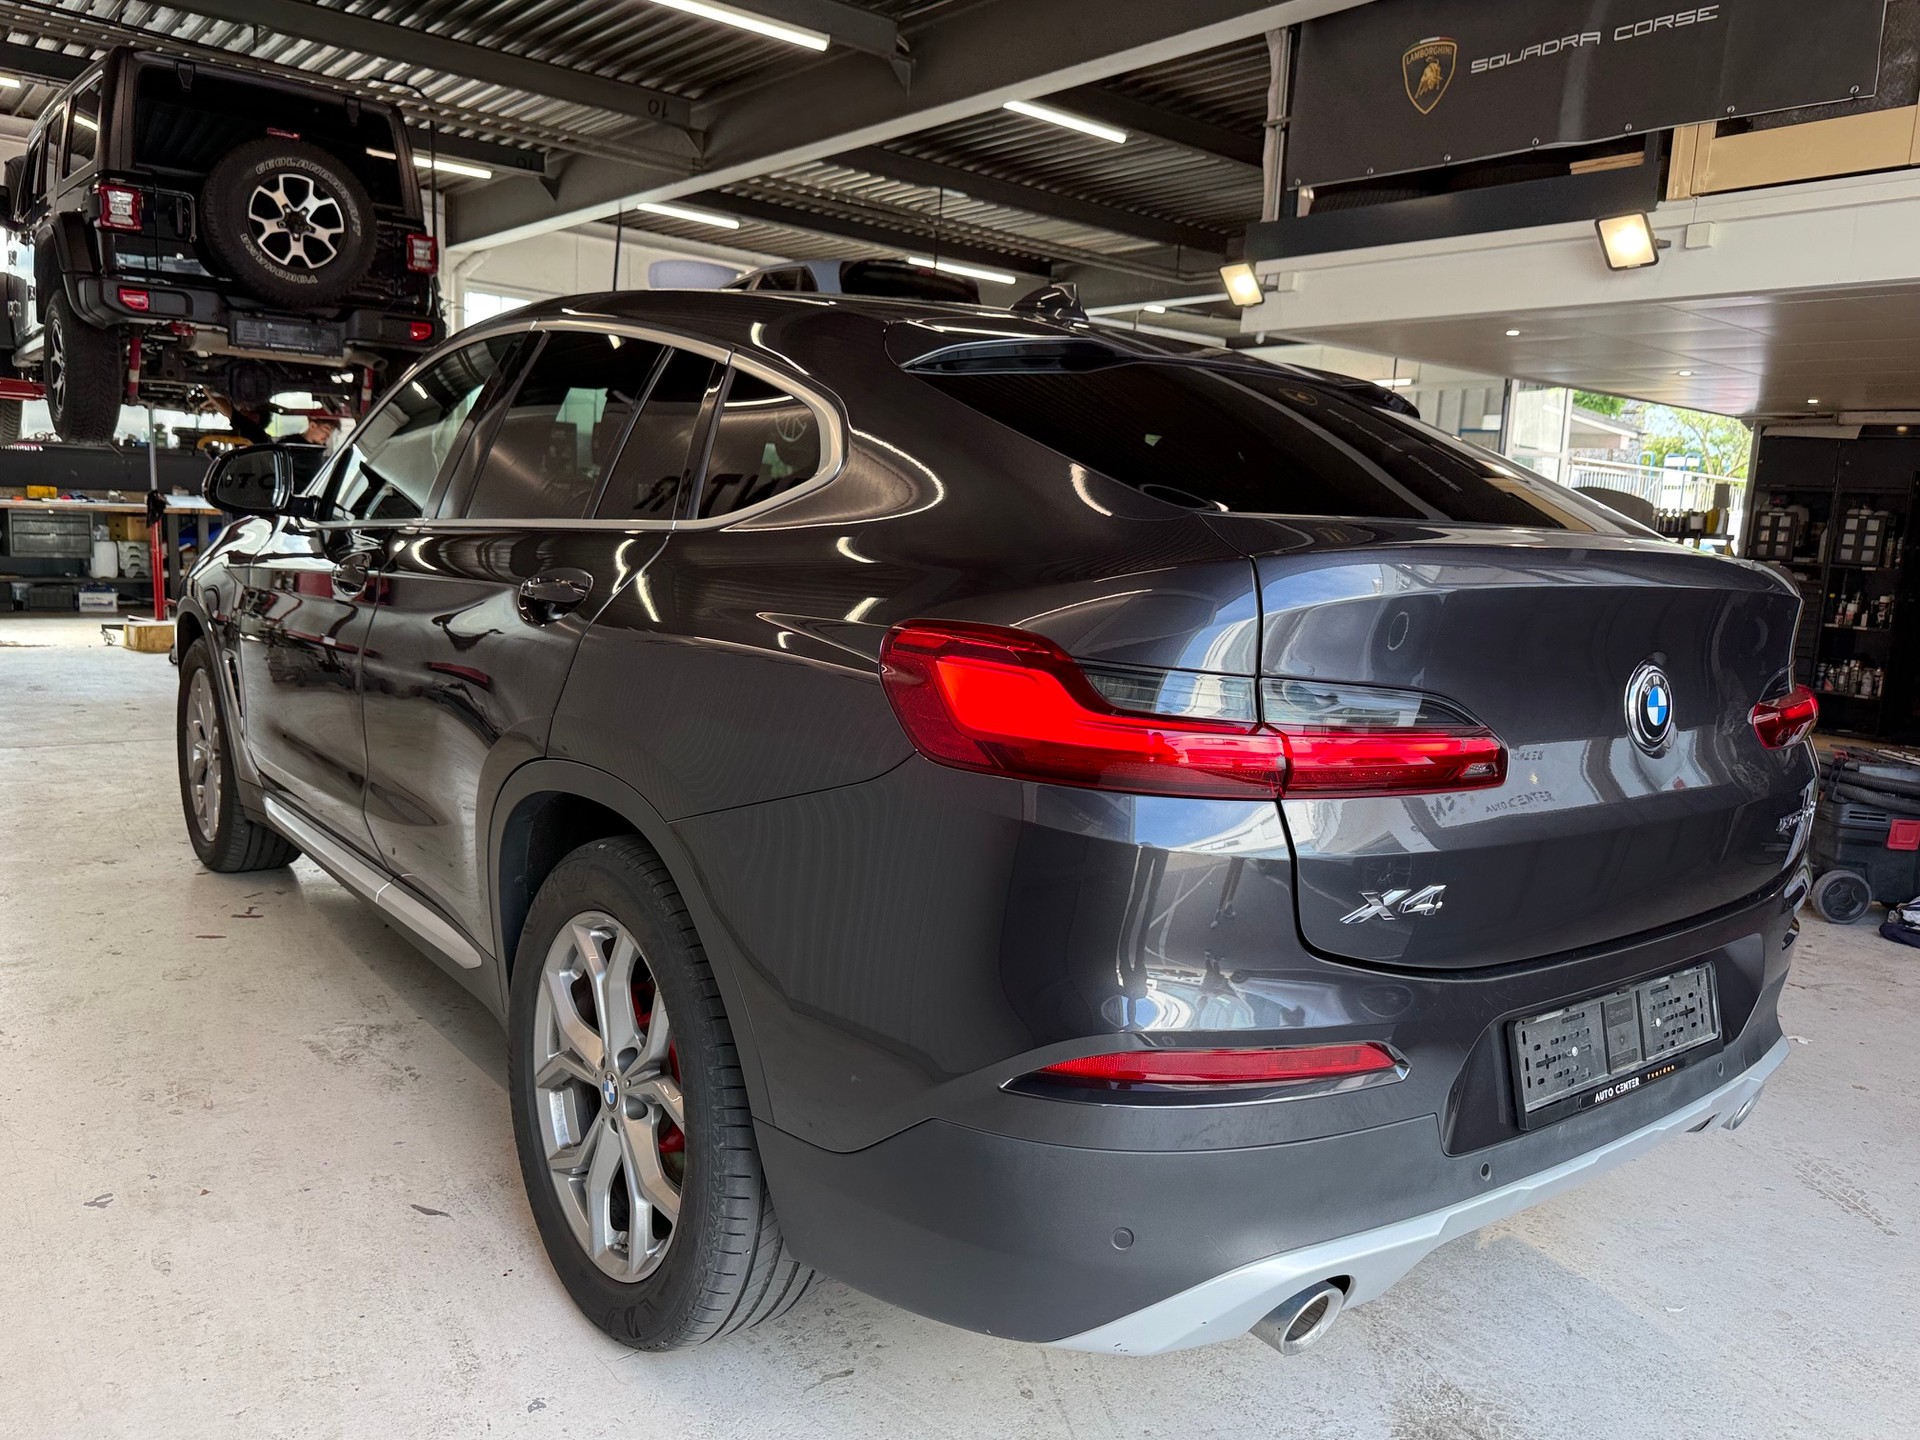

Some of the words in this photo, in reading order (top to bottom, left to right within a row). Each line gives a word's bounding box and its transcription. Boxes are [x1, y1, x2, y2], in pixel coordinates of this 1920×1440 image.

[1406, 46, 1453, 65] LAMBORGHINI
[1470, 31, 1601, 74] SQUADRA
[1613, 4, 1720, 41] CORSE
[1339, 884, 1447, 925] X4
[1594, 1088, 1614, 1103] AUTO
[1615, 1077, 1640, 1093] CENTER
